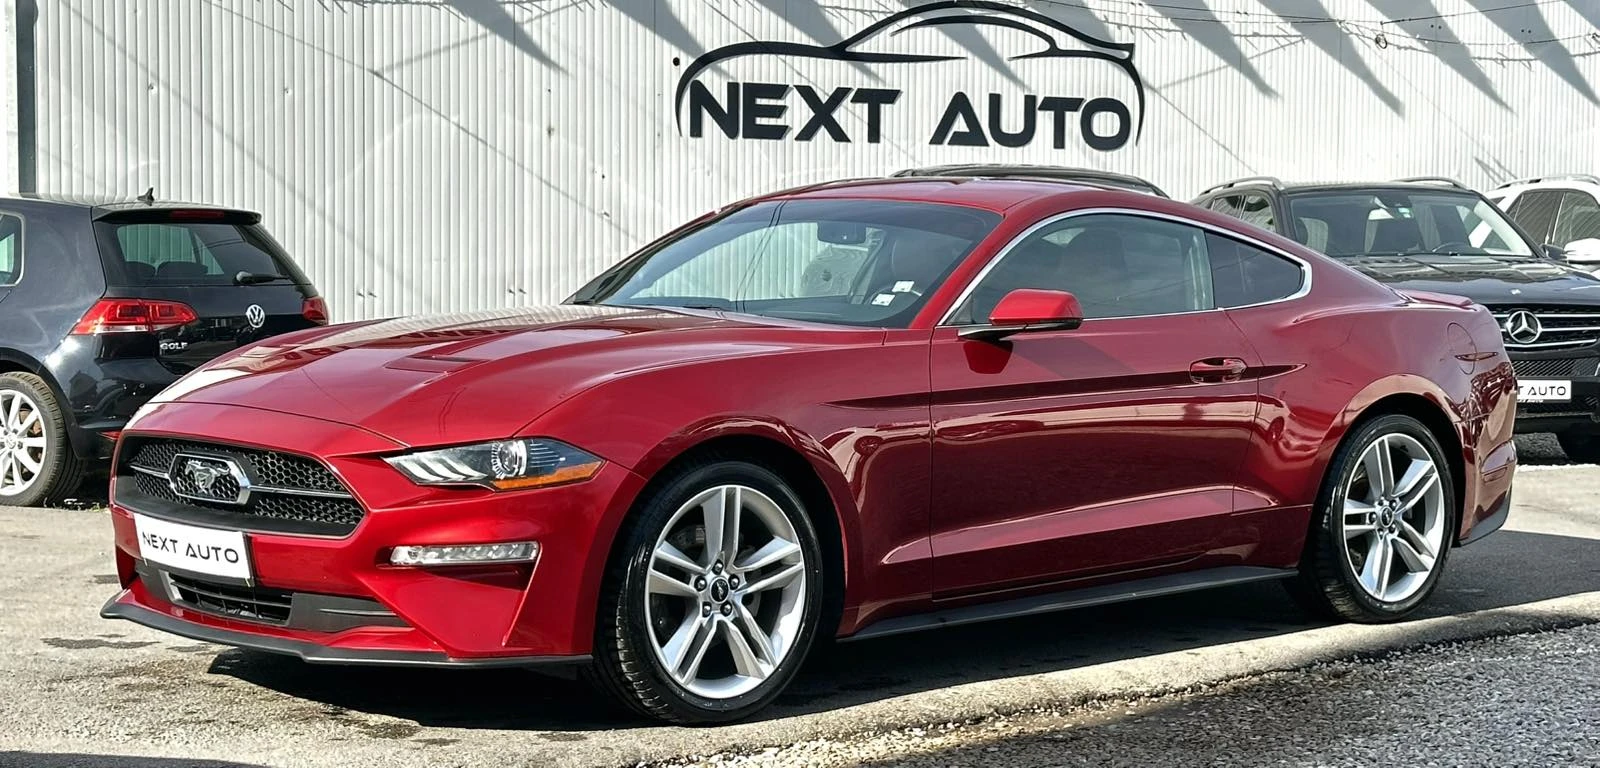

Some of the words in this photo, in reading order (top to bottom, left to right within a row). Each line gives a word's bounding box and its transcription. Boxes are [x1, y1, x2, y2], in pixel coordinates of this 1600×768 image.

[690, 79, 901, 144] NEXT
[929, 91, 1132, 151] AUTO
[160, 342, 188, 350] GOLF
[1528, 386, 1566, 396] AUTO
[142, 531, 178, 554] NEXT
[185, 543, 239, 564] AUTO
